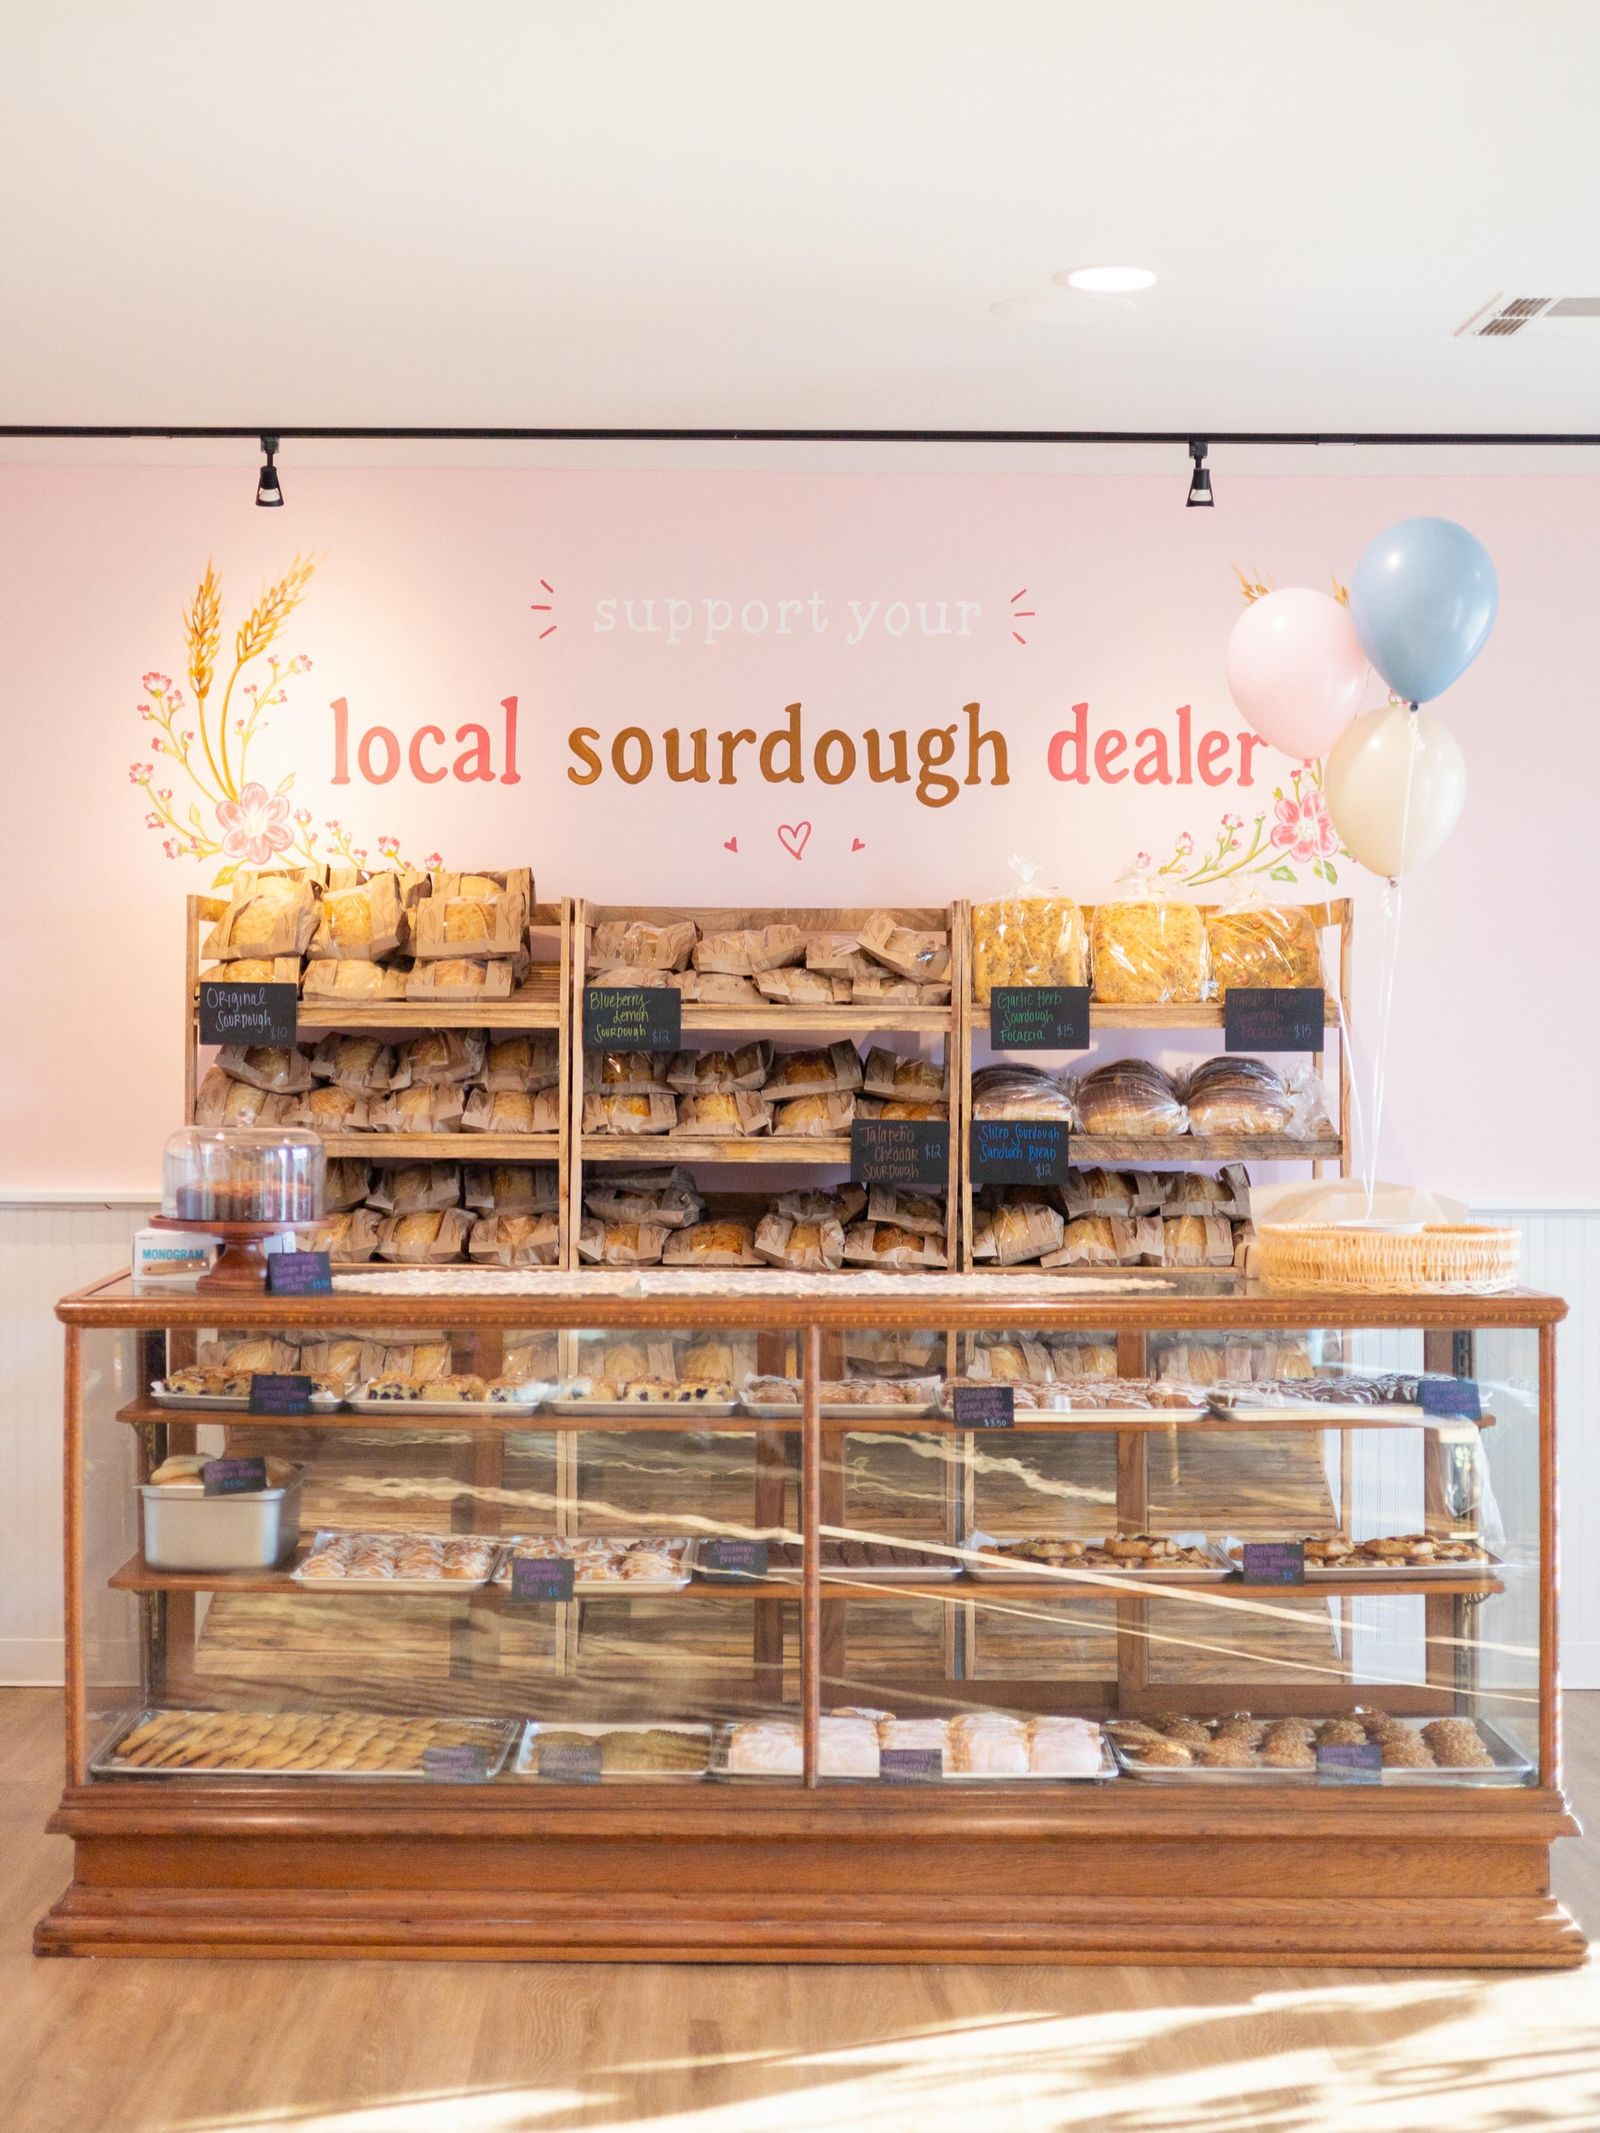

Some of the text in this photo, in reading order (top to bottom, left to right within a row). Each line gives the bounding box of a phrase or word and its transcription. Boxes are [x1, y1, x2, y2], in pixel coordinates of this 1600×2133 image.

[594, 589, 982, 645] support your
[329, 695, 1269, 808] local sourdough dealer
[590, 991, 652, 1011] Blueberry
[143, 1248, 204, 1260] MONOGRAM
